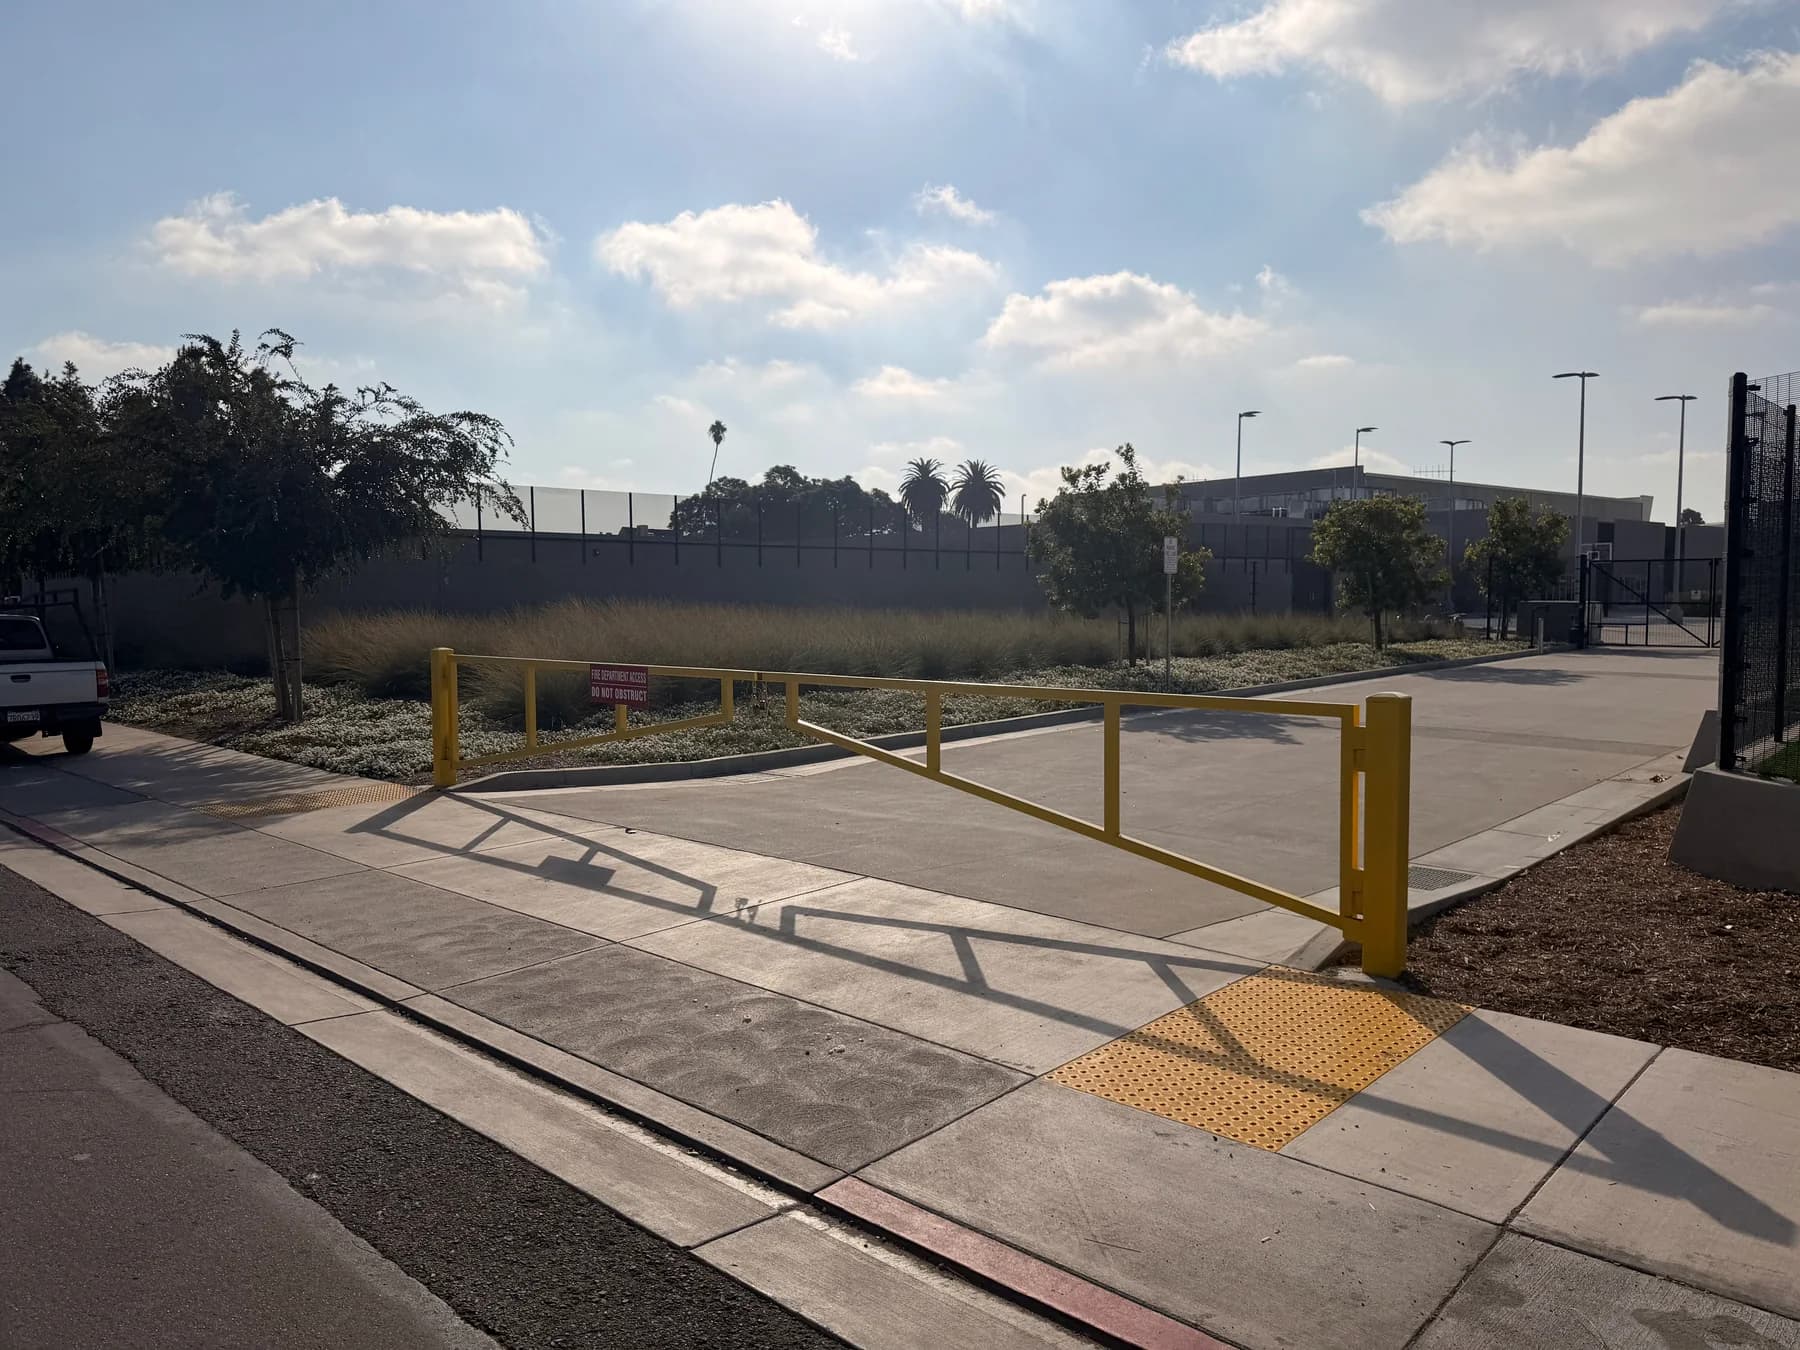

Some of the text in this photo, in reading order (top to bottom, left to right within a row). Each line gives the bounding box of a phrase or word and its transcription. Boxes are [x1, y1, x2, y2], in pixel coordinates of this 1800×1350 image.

[592, 669, 647, 683] FIRE DEPARTMENT ACCESS
[592, 686, 647, 702] DO NOT OBSTRUCT
